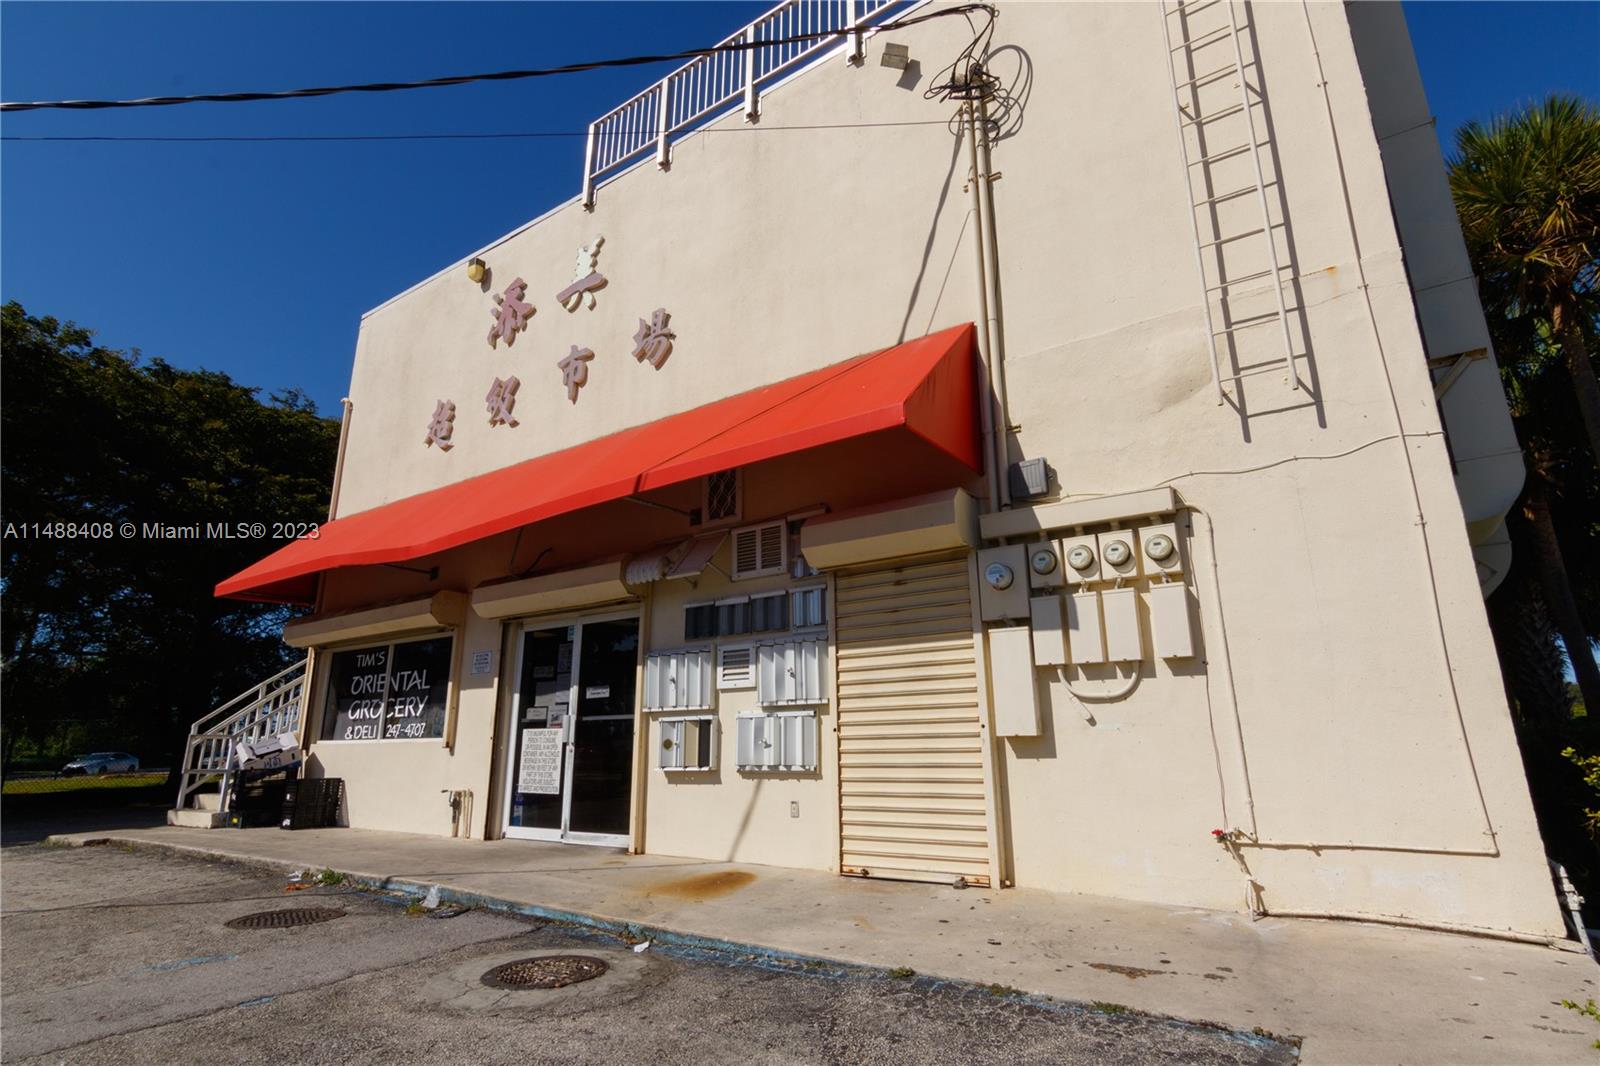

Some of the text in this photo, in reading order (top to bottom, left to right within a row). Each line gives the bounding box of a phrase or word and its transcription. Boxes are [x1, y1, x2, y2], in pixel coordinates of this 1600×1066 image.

[356, 651, 386, 668] TIM'S
[351, 669, 431, 695] ORIENTAL
[348, 695, 429, 720] GROCERY
[386, 722, 426, 738] 247-4707
